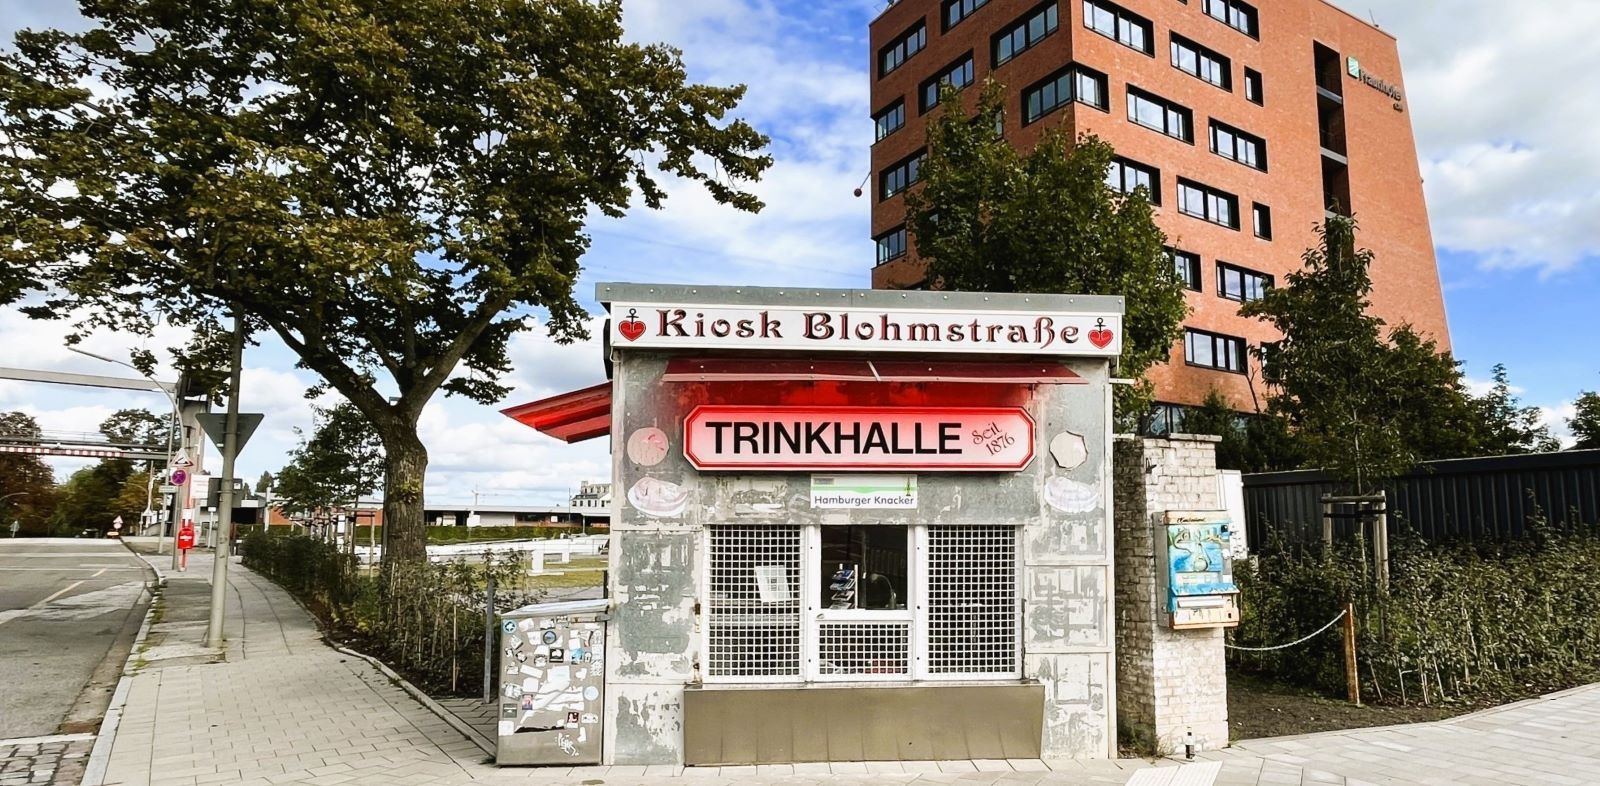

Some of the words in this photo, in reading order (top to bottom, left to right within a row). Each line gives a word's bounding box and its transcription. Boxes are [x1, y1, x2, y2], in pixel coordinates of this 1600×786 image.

[655, 309, 783, 338] Kiosk
[802, 311, 1079, 349] Blohmstraße
[705, 421, 963, 454] TRINKHALLE
[985, 432, 1015, 456] 1876
[814, 495, 871, 506] Hamburger
[874, 495, 914, 505] Knacker
